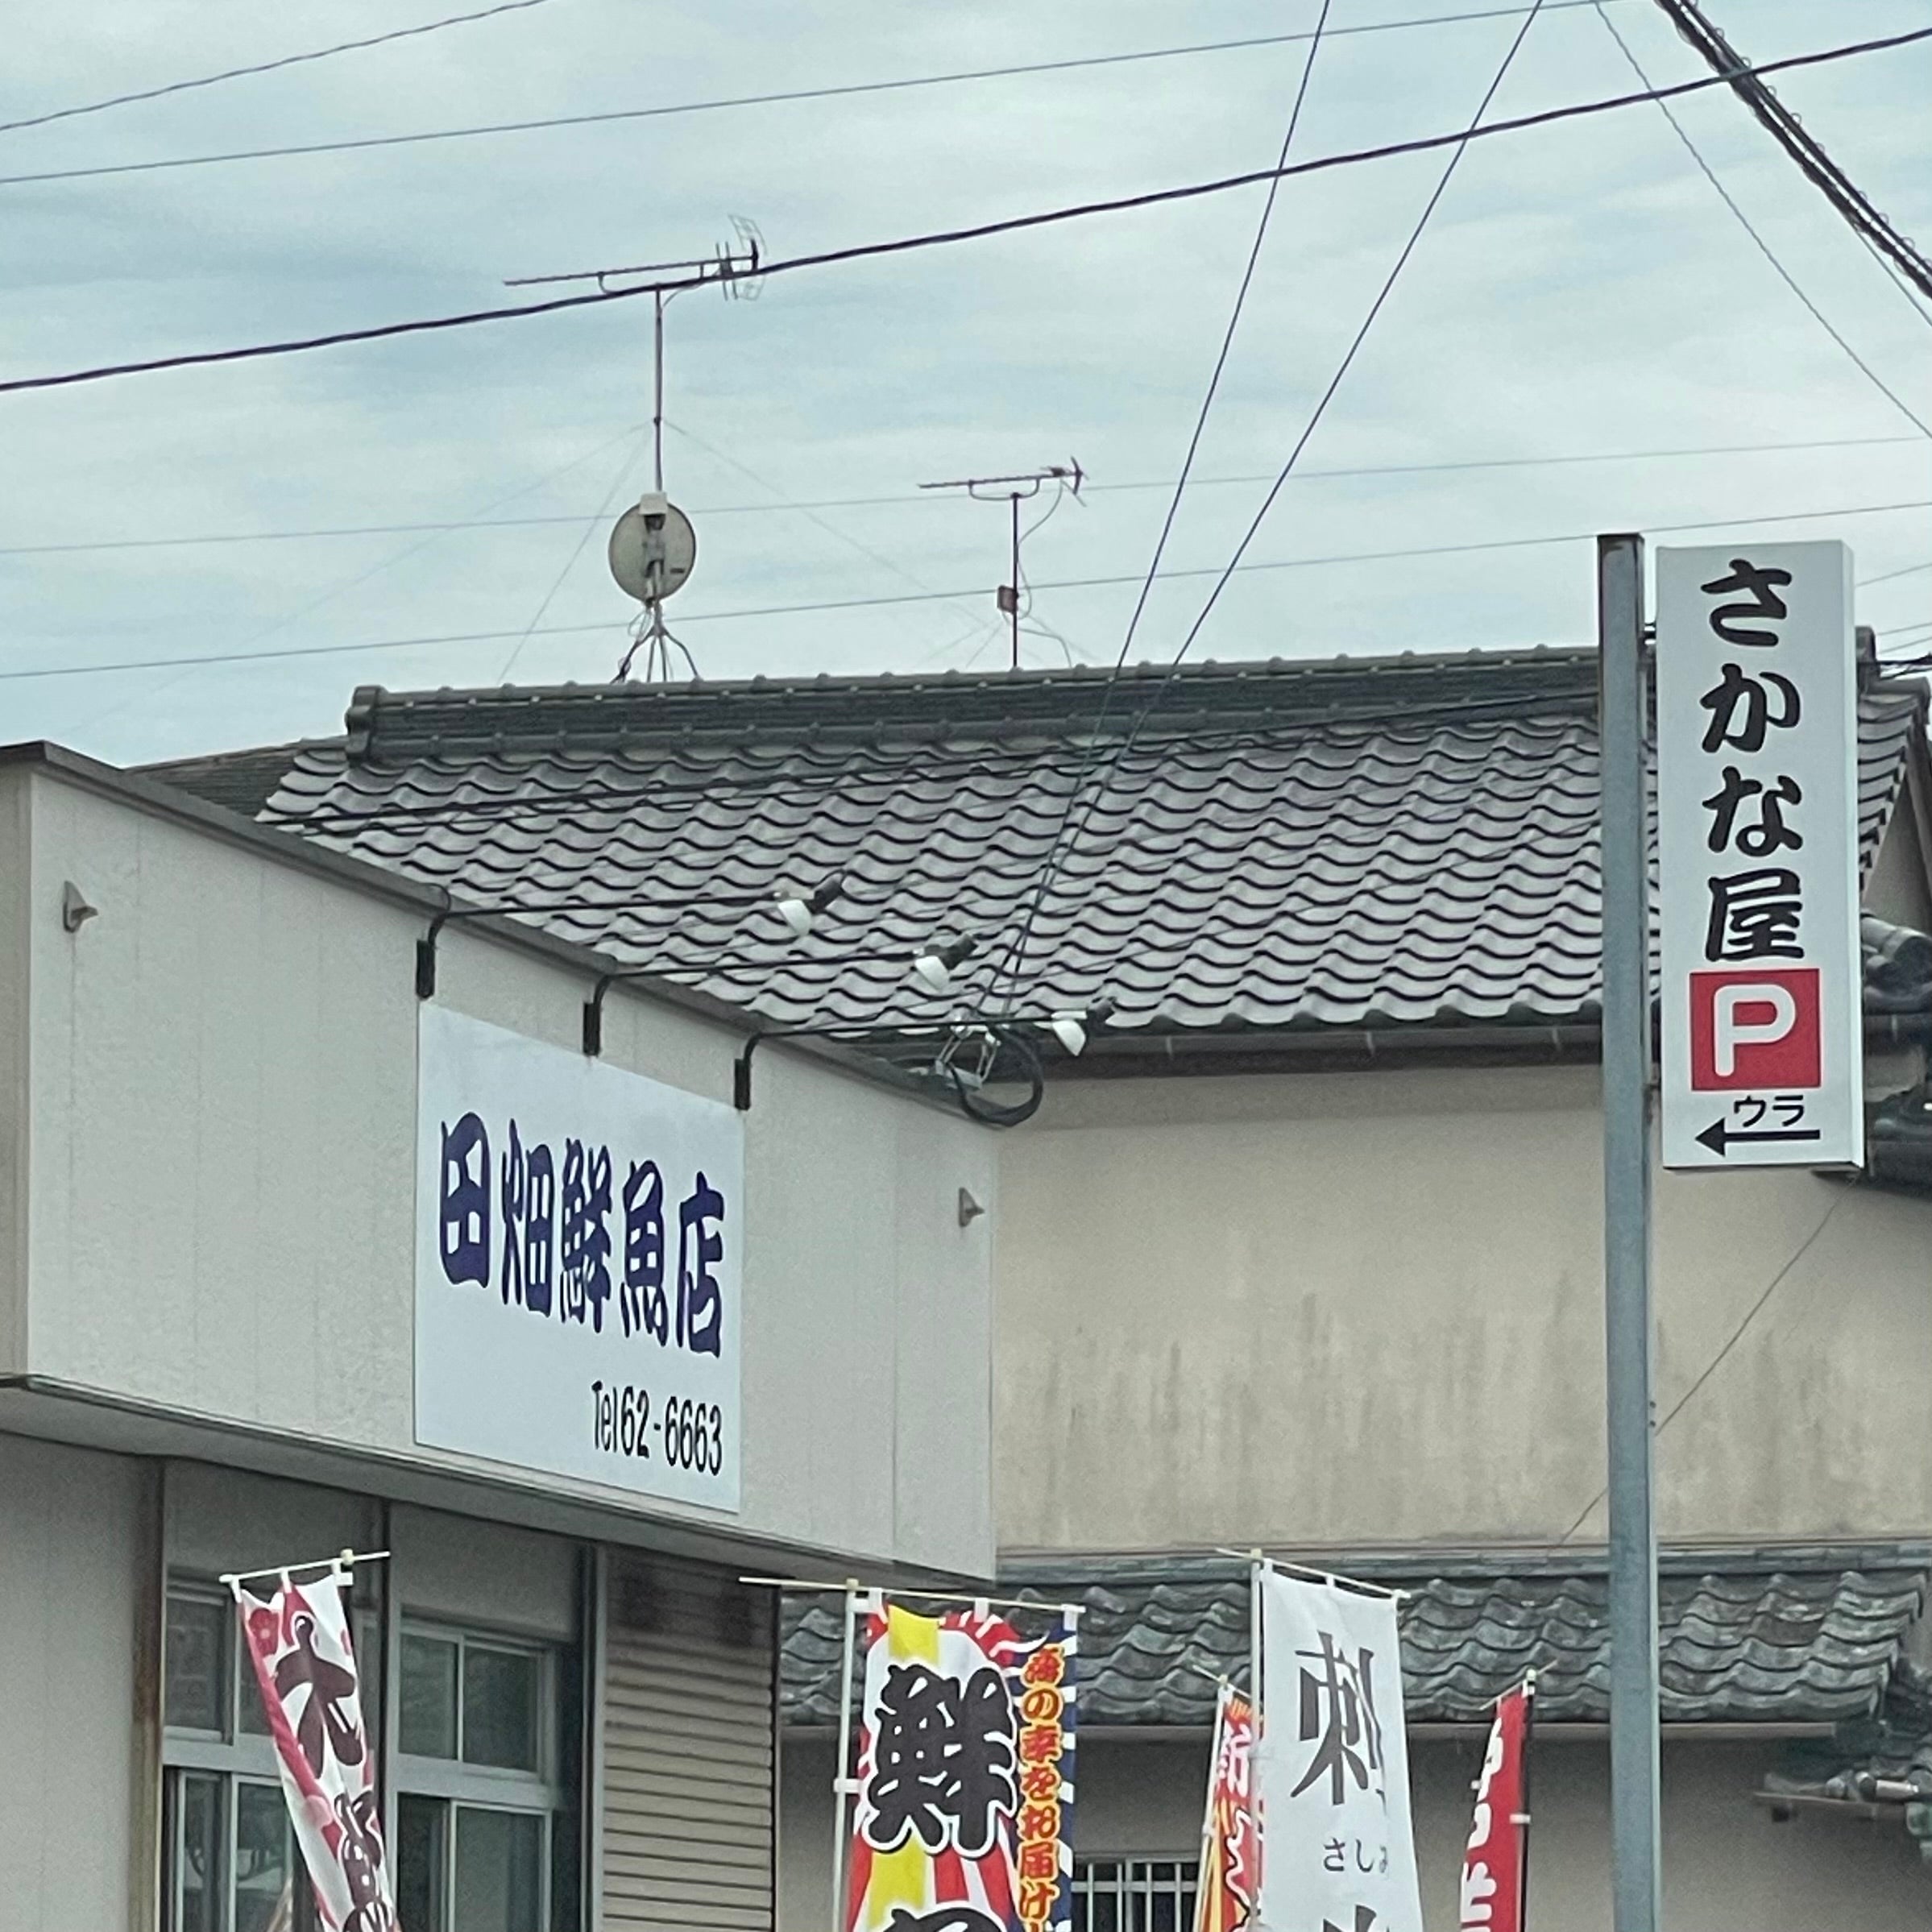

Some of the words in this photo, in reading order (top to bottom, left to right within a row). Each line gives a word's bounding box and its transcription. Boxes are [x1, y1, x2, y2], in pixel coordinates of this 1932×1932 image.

[1700, 559, 1805, 962] さかな屋
[1714, 984, 1797, 1076] P
[1733, 1094, 1806, 1128] ウラ
[439, 1112, 725, 1358] 田畑鮮魚店
[1018, 1645, 1066, 1932] 海の幸をお届け
